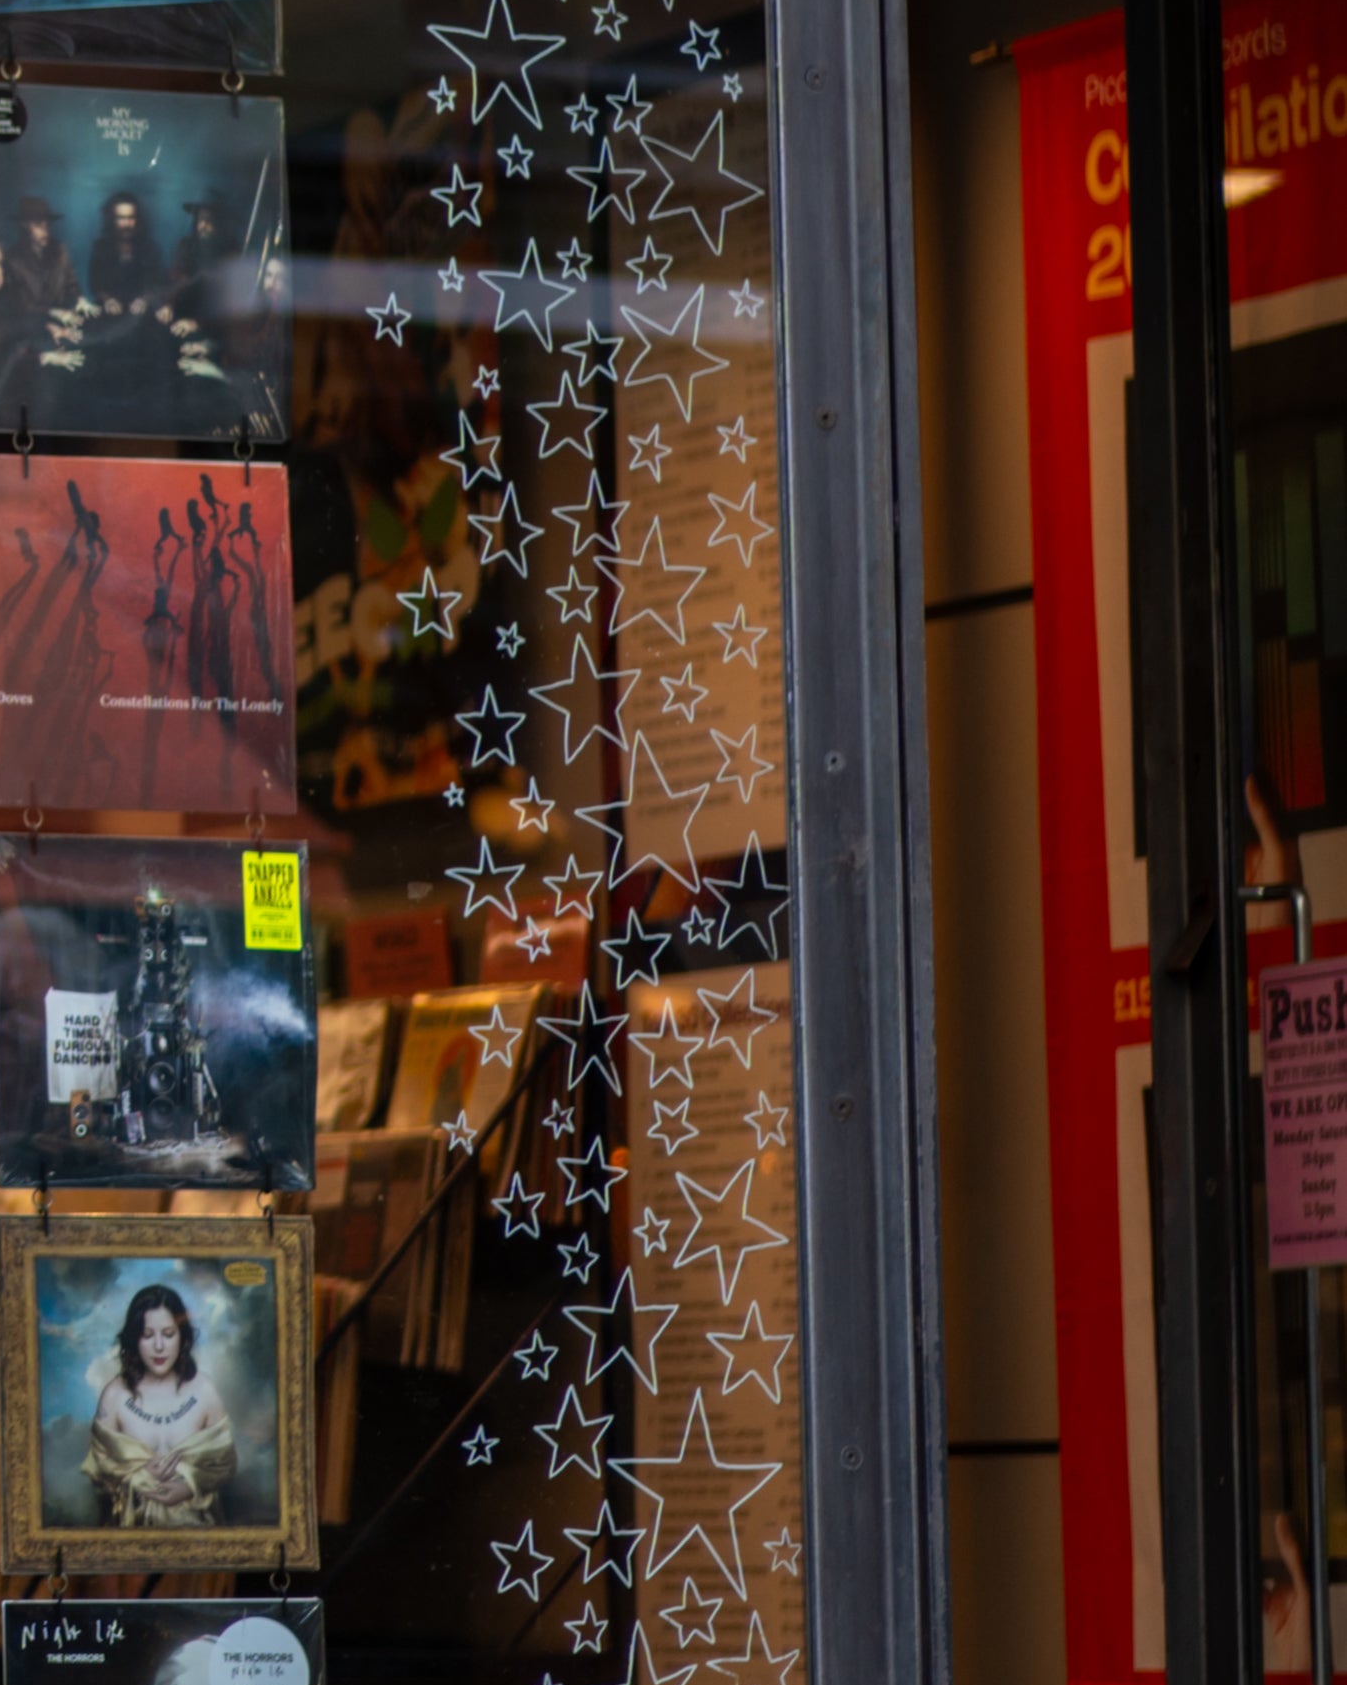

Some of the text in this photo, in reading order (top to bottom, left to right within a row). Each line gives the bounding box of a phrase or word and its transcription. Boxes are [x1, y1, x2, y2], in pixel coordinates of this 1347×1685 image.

[99, 694, 285, 716] Constellations For The Lonely
[64, 1015, 101, 1027] HARD
[1270, 1095, 1321, 1120] WE ARE
[47, 1653, 106, 1664] THE HORRORS
[223, 1652, 294, 1664] THE HORRORS
